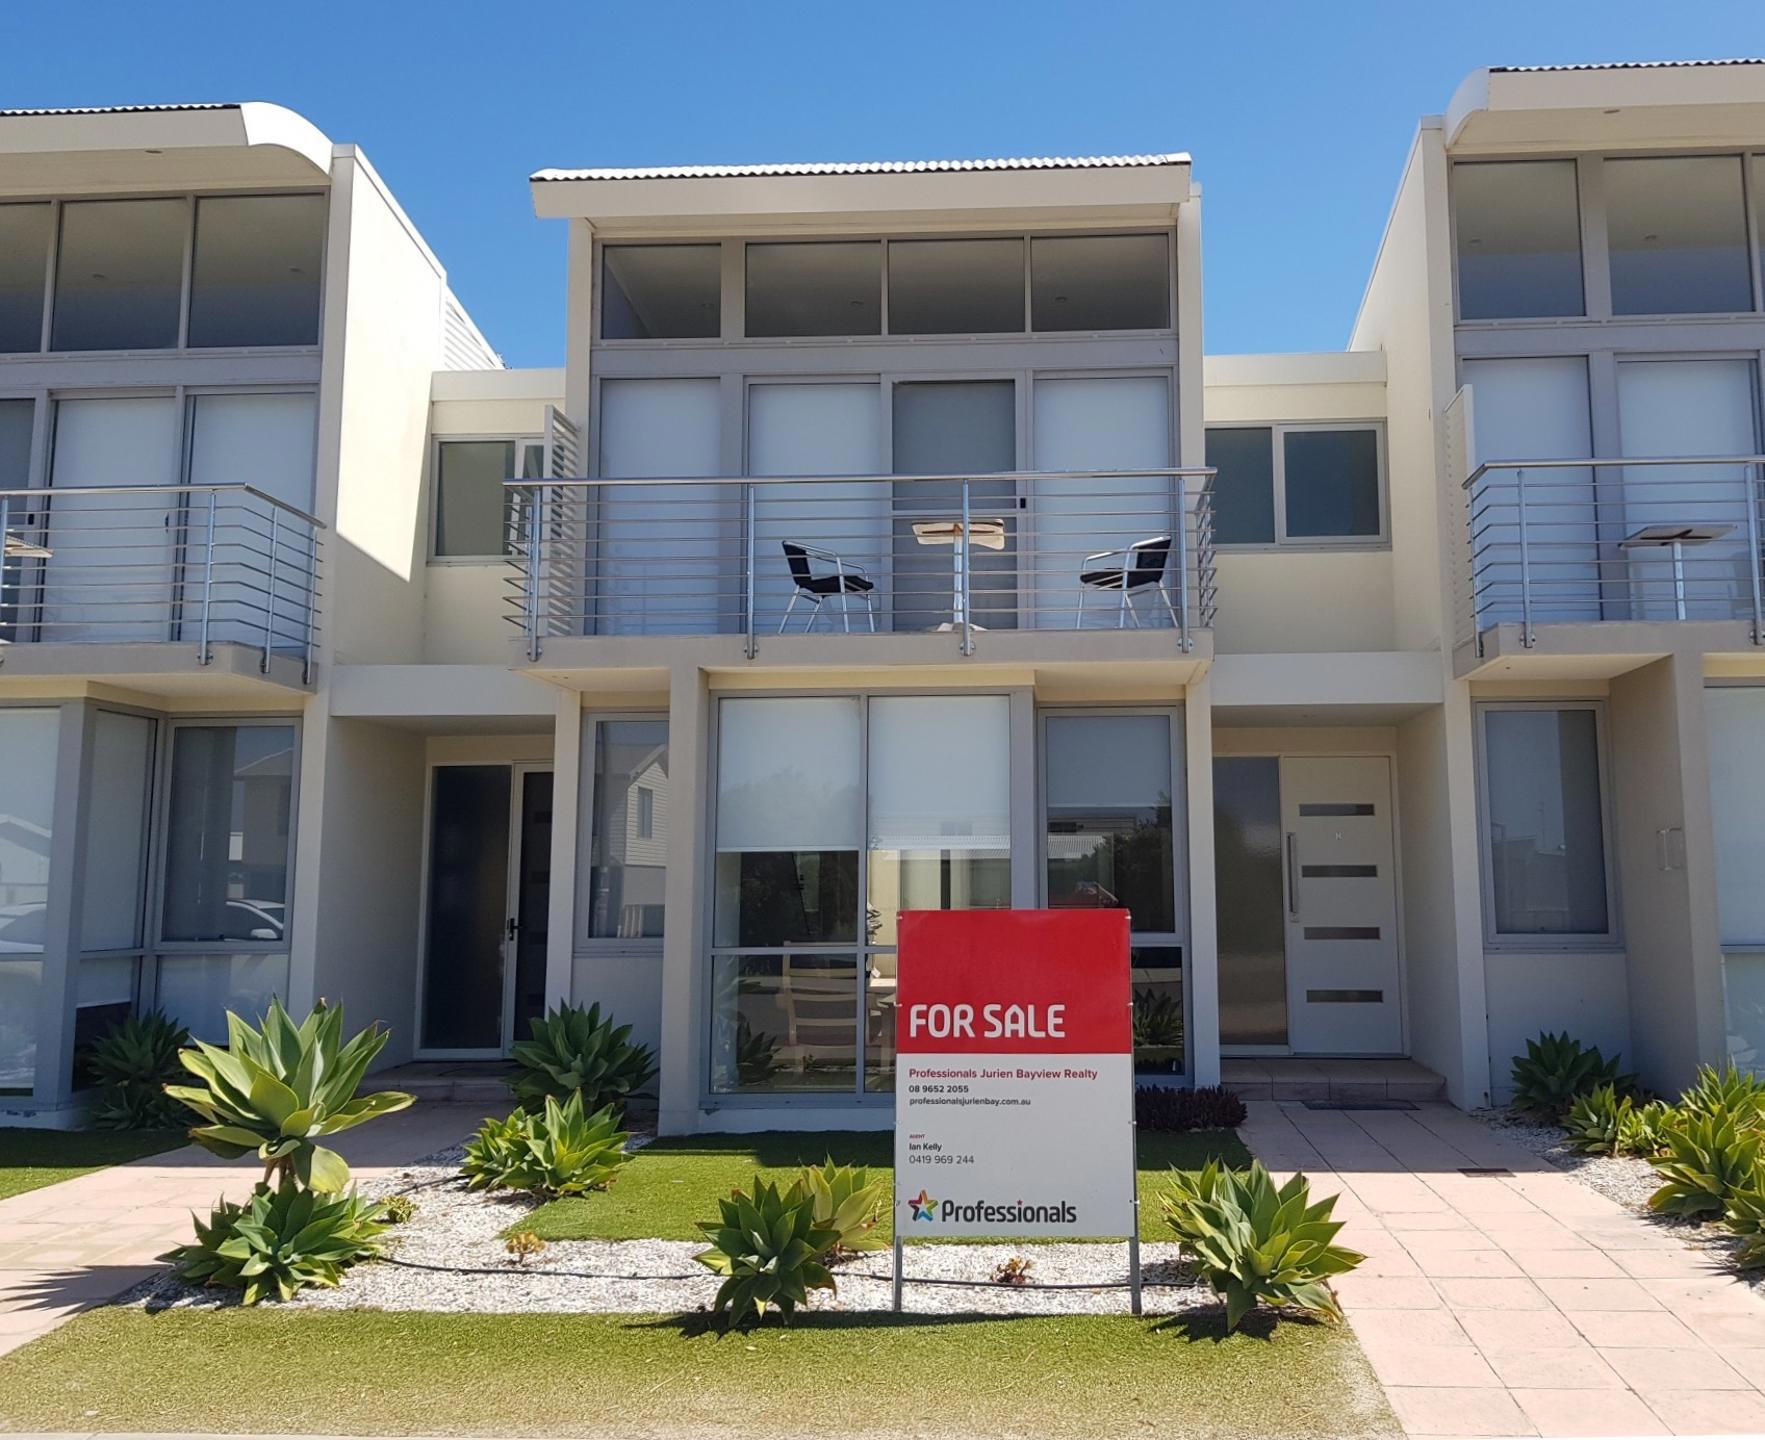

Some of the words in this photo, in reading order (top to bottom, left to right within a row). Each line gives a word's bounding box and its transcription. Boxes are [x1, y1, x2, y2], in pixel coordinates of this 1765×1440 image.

[909, 1003, 975, 1038] FOR
[983, 1003, 1065, 1038] SALE
[908, 1068, 977, 1079] Professionals
[980, 1068, 1013, 1079] Jurien
[1016, 1068, 1061, 1081] Bayview
[1064, 1068, 1098, 1081] Realty
[908, 1084, 920, 1094] 08
[922, 1084, 945, 1094] 9652
[947, 1084, 969, 1094] 2055
[909, 1096, 1031, 1107] professionalsjurienbay.com.au
[908, 1142, 921, 1151] Ian
[923, 1142, 942, 1153] Kelly
[908, 1154, 932, 1165] 0419
[934, 1154, 953, 1165] 969
[956, 1154, 975, 1165] 244
[942, 1199, 1077, 1223] Professionals
